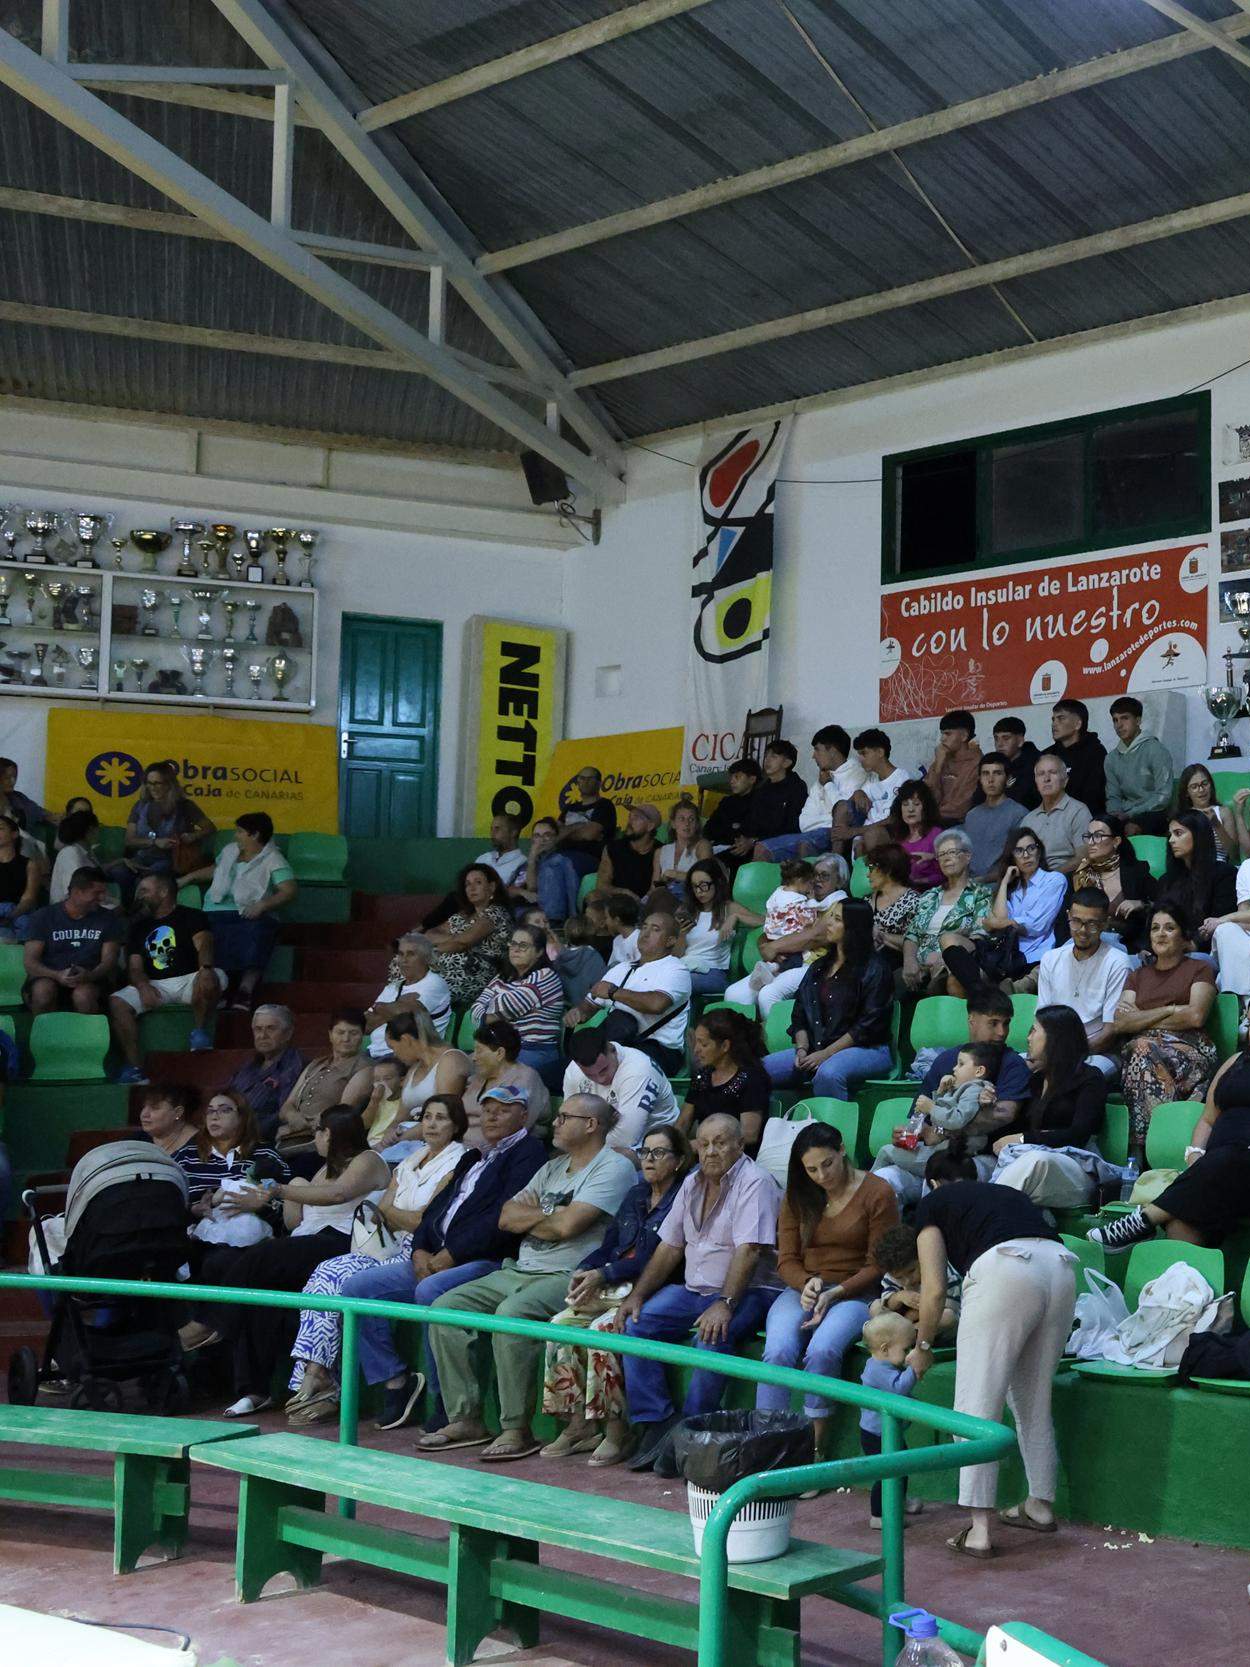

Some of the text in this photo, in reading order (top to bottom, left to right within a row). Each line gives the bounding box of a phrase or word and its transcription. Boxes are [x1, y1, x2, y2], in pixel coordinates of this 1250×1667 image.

[900, 561, 1162, 618] Cabildo Insular de Lanzarote
[911, 585, 1161, 658] con lo nuestro
[1082, 618, 1199, 675] www.lanzarotedeportes.com
[491, 640, 541, 829] NETTO
[183, 784, 222, 798] Caja
[244, 789, 304, 801] CANARIAS
[600, 771, 681, 793] ObraSOCIA
[52, 928, 102, 941] COURAGE
